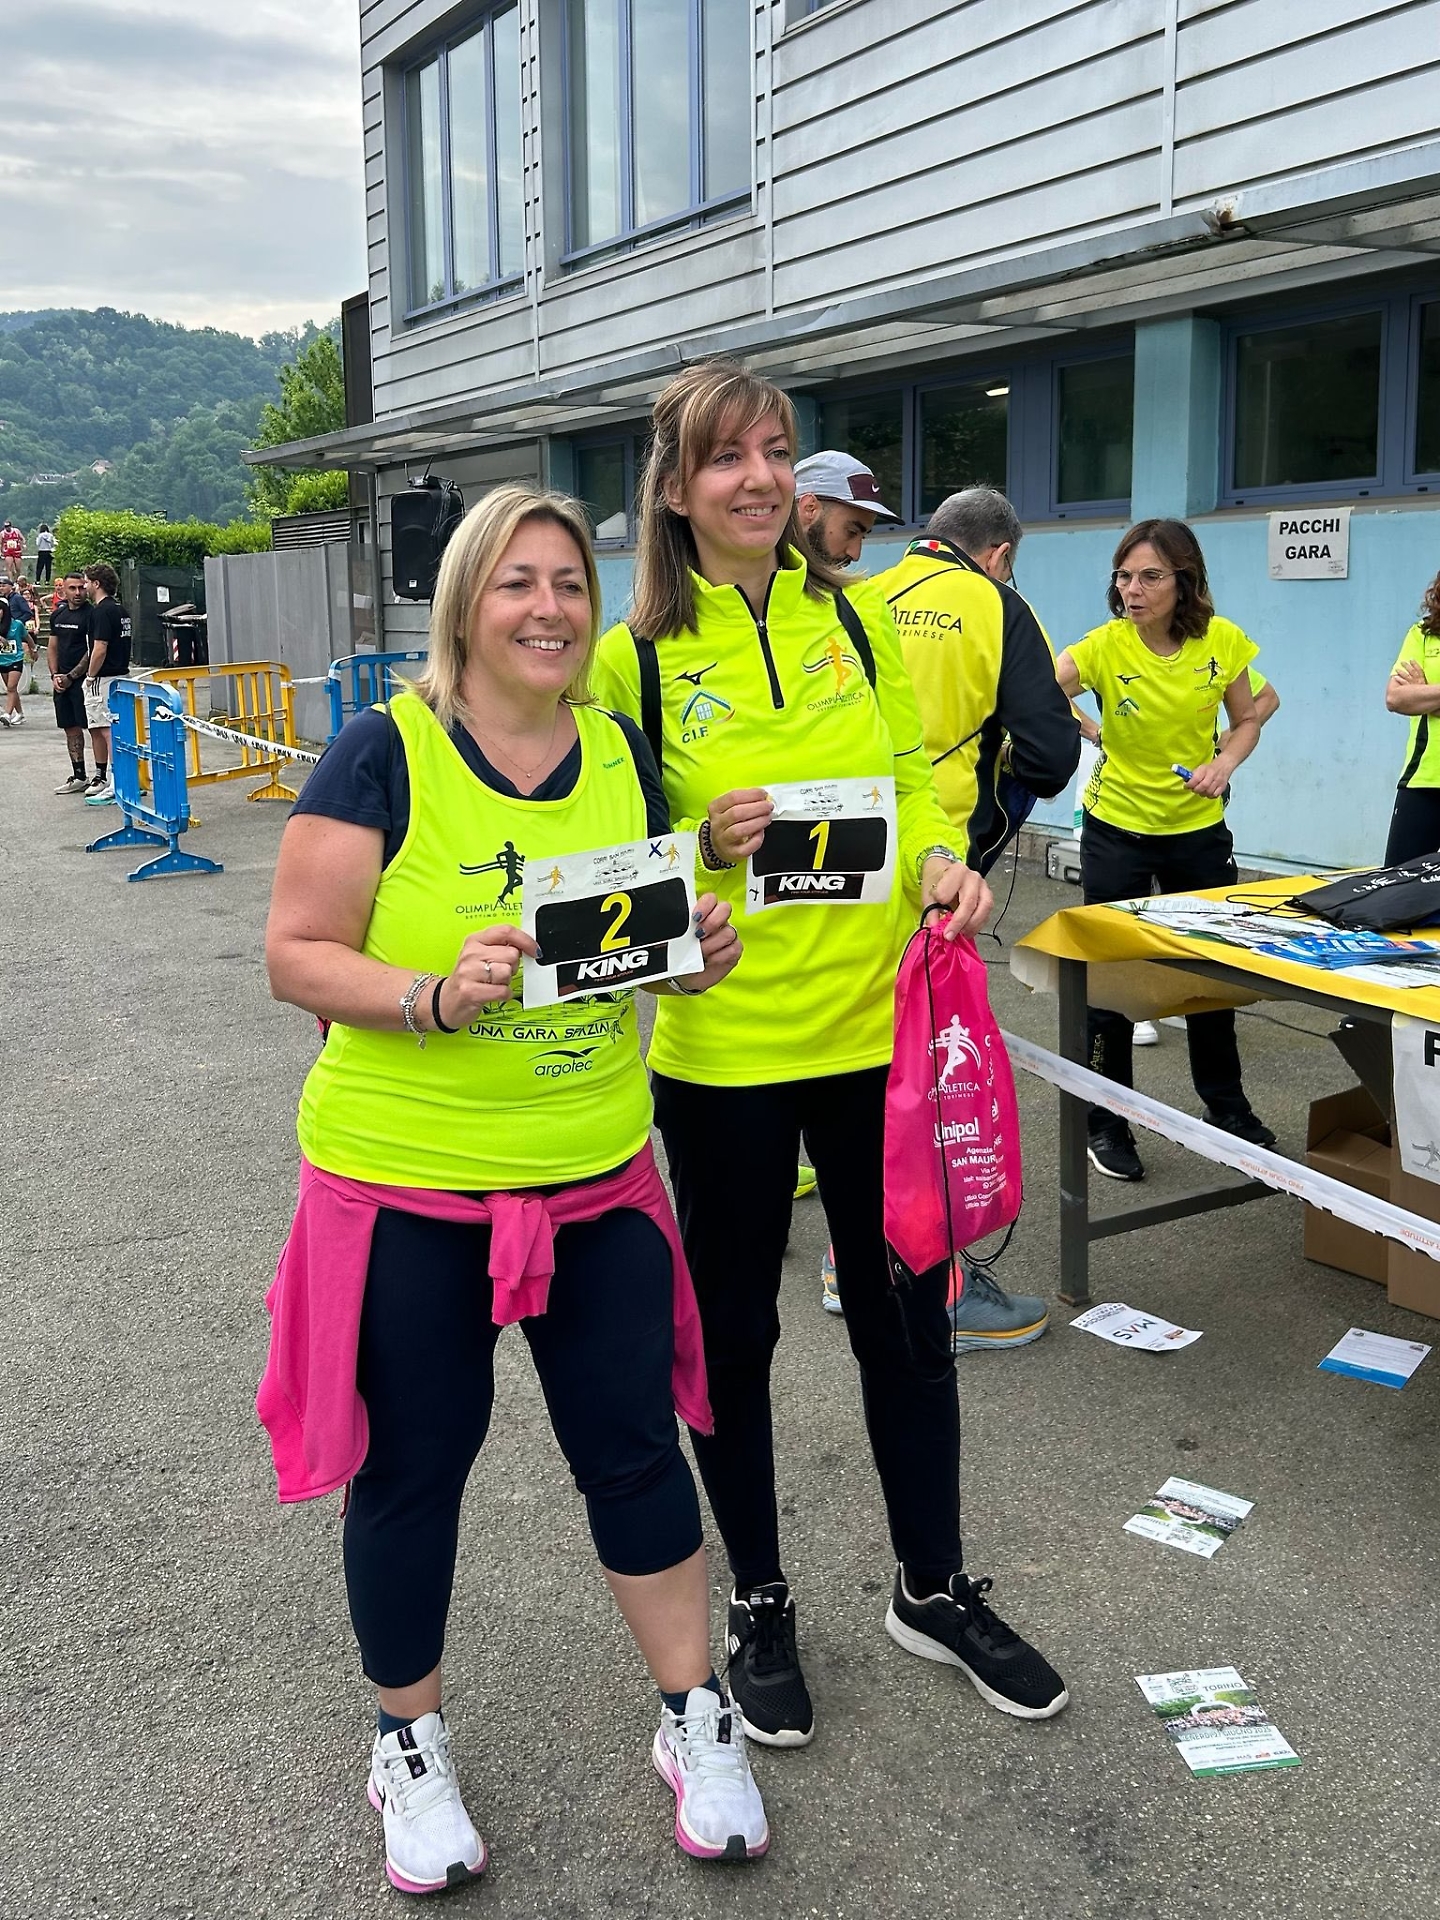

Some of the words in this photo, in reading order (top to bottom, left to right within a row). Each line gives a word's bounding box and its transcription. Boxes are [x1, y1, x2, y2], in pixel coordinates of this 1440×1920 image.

[1279, 518, 1340, 535] PACCHI
[1285, 545, 1331, 560] GARA
[682, 725, 709, 744] C.I.F.
[808, 820, 831, 871] 1
[778, 875, 846, 892] KING
[600, 891, 632, 954] 2
[576, 949, 650, 982] KING
[469, 1023, 505, 1039] UNA
[512, 1027, 558, 1041] GARA
[534, 1058, 594, 1078] argotec
[934, 1116, 981, 1143] Unipol
[951, 1158, 968, 1168] SAN
[1112, 1318, 1157, 1341] MAS
[1203, 1681, 1243, 1692] TORINO
